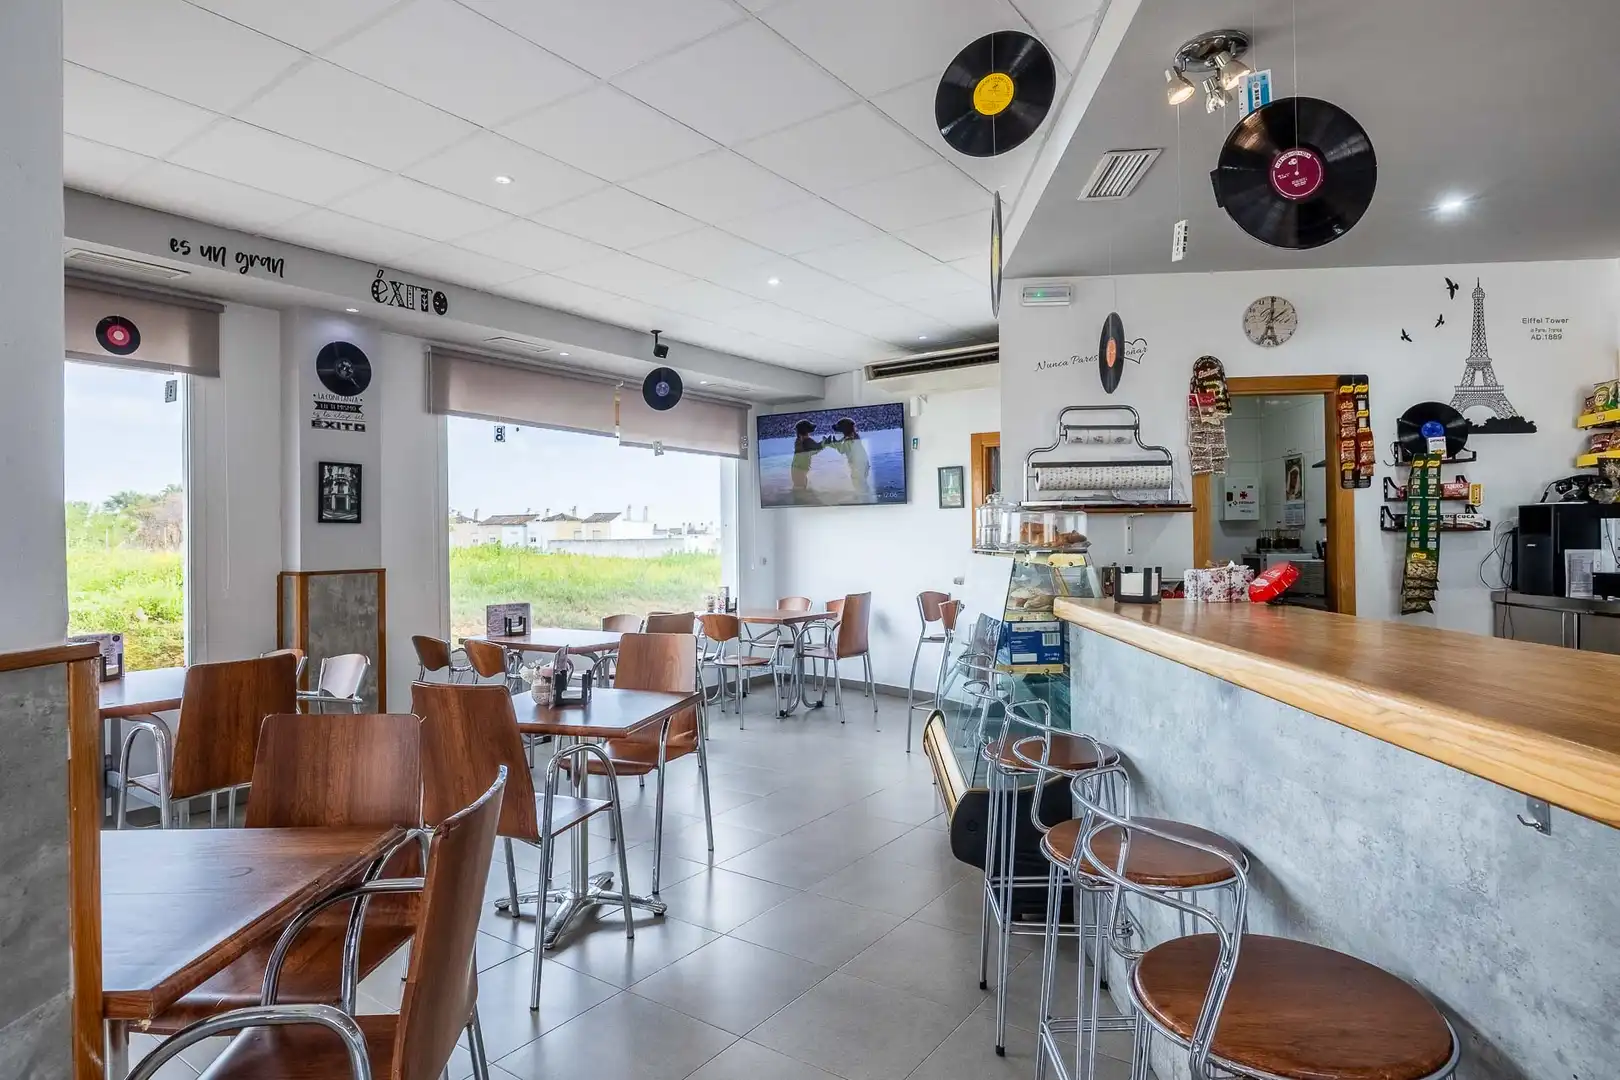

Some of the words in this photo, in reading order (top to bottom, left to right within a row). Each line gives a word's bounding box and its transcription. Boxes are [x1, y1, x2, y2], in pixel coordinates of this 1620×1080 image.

[170, 236, 191, 256] es
[200, 243, 226, 267] un
[235, 252, 285, 279] gran
[1034, 359, 1069, 372] Nunca
[1070, 354, 1098, 365] Pares
[1123, 346, 1147, 357] oñar
